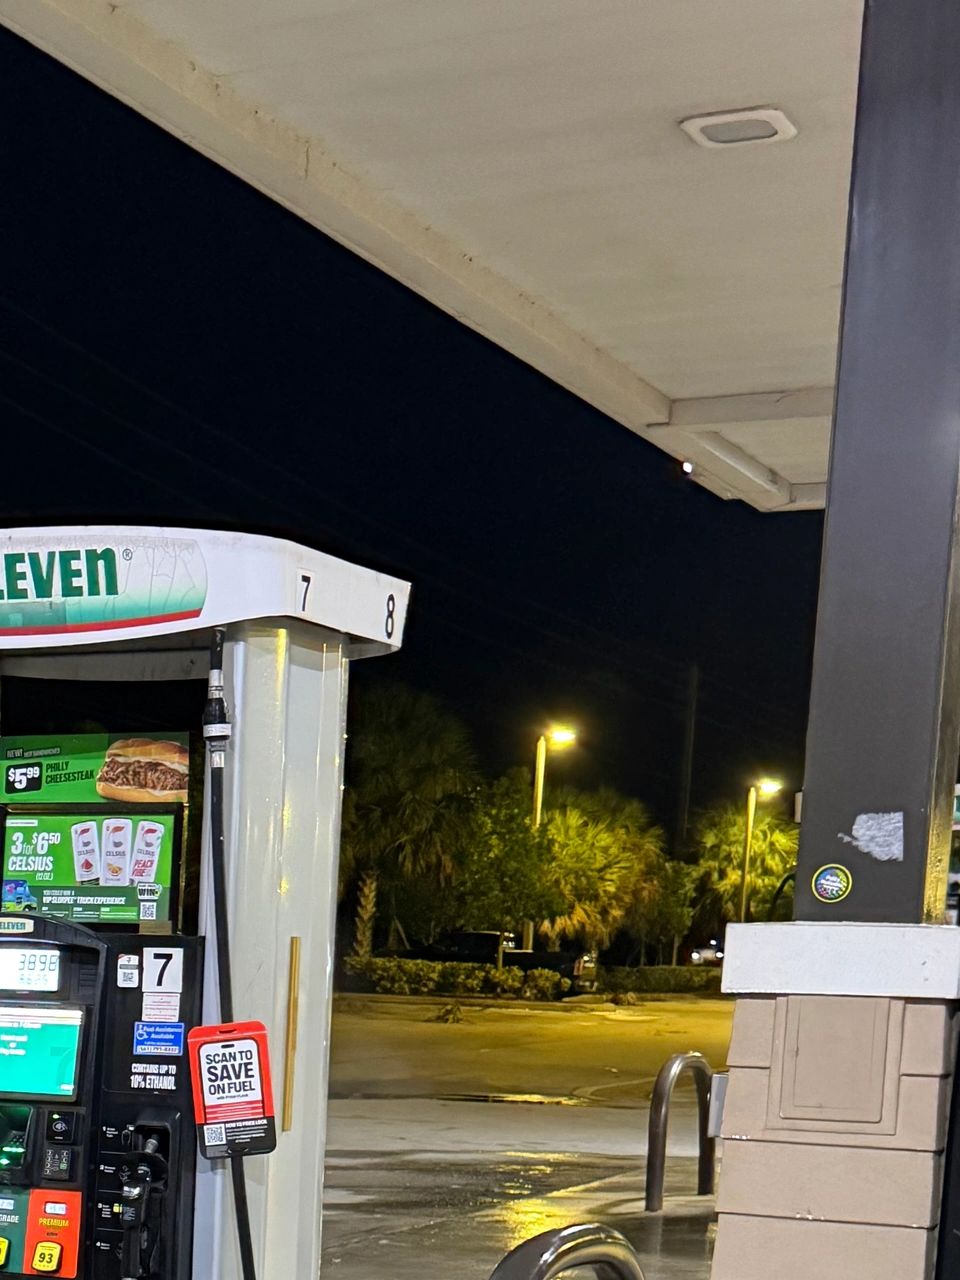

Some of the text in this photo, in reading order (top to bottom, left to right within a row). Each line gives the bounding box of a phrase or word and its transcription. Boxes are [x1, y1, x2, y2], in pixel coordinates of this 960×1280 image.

[301, 574, 311, 612] 7
[385, 593, 395, 640] 8
[45, 761, 70, 773] PHILLY
[45, 769, 95, 785] CHEESESTEAK
[10, 832, 24, 855] 3
[23, 842, 35, 855] for
[8, 856, 54, 871] CELSIUS
[153, 953, 173, 987] 7
[205, 1049, 253, 1065] SCAN TO
[131, 1063, 177, 1075] CONTAINS UP TO
[207, 1061, 255, 1083] SAVE
[130, 1074, 177, 1090] 10% ETHANOL
[208, 1083, 226, 1096] ON
[227, 1080, 256, 1094] FUEL
[38, 1217, 69, 1227] PREMIUM
[38, 1252, 54, 1264] 93
